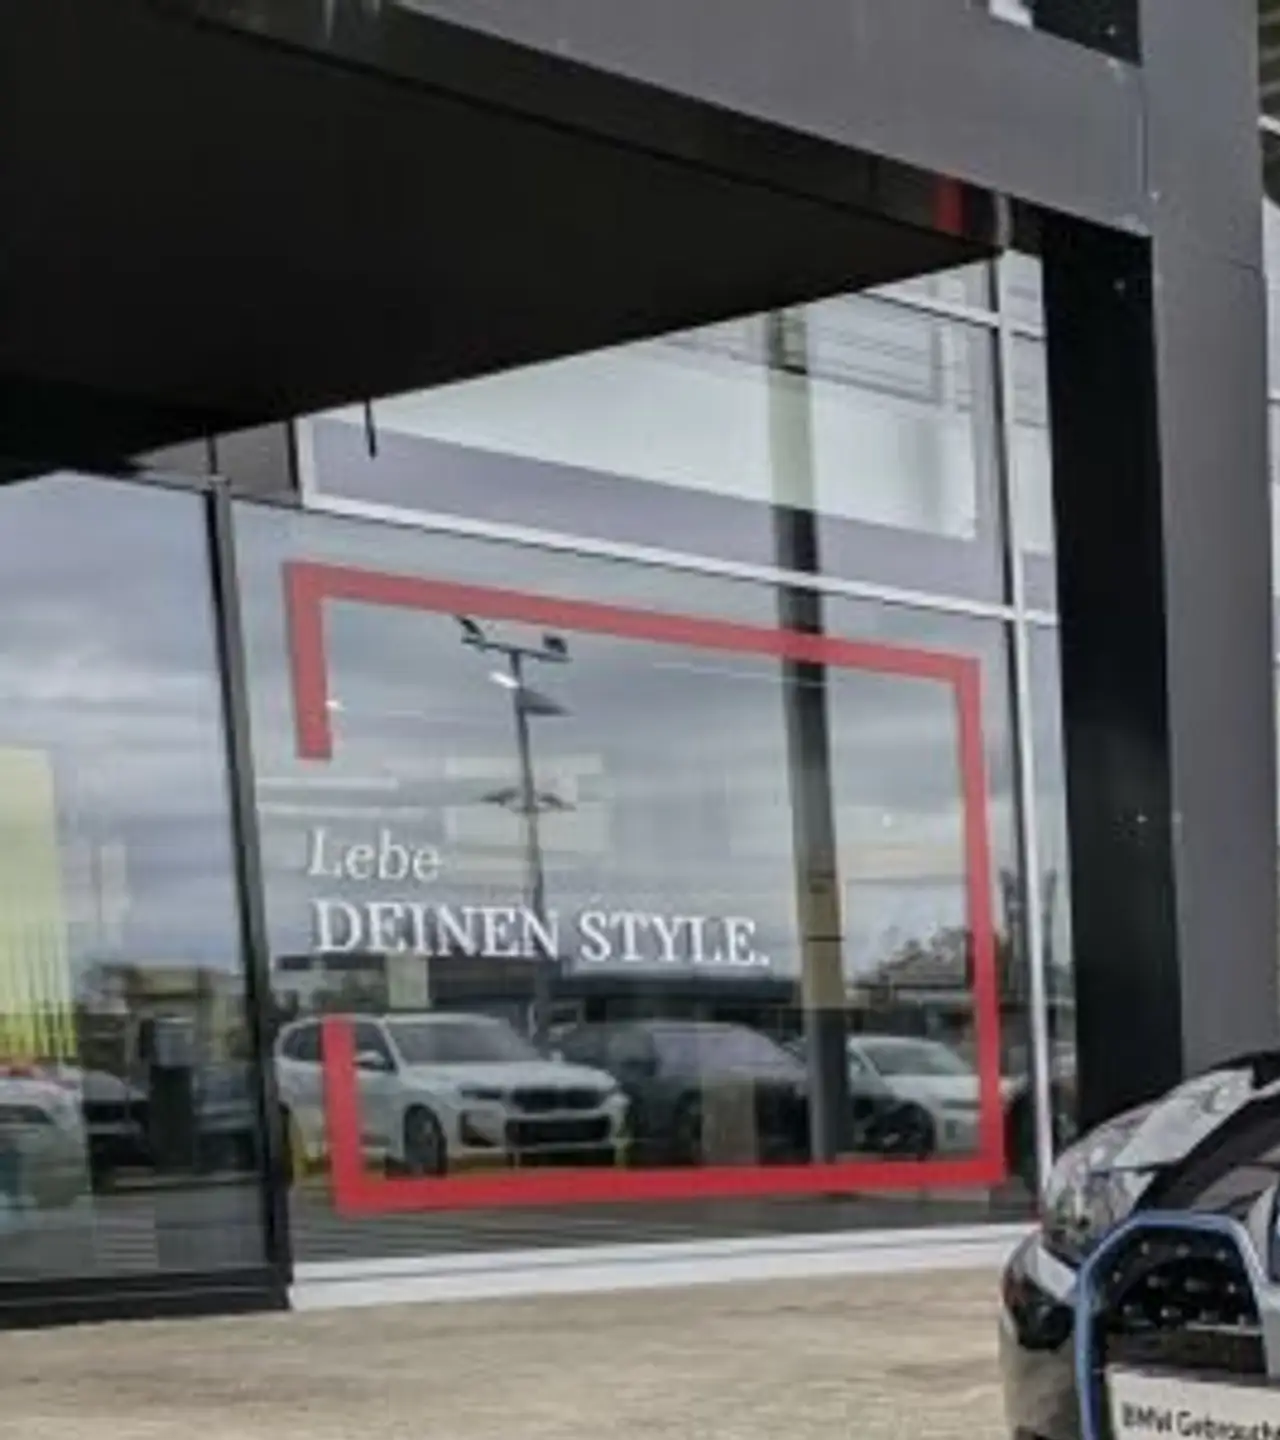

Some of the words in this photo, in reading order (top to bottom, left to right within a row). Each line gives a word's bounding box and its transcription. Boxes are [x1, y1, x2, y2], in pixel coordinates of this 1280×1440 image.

[309, 828, 440, 881] Lebe
[315, 899, 559, 957] DEINEN
[580, 910, 771, 967] STYLE.
[1123, 1402, 1173, 1433] BMW
